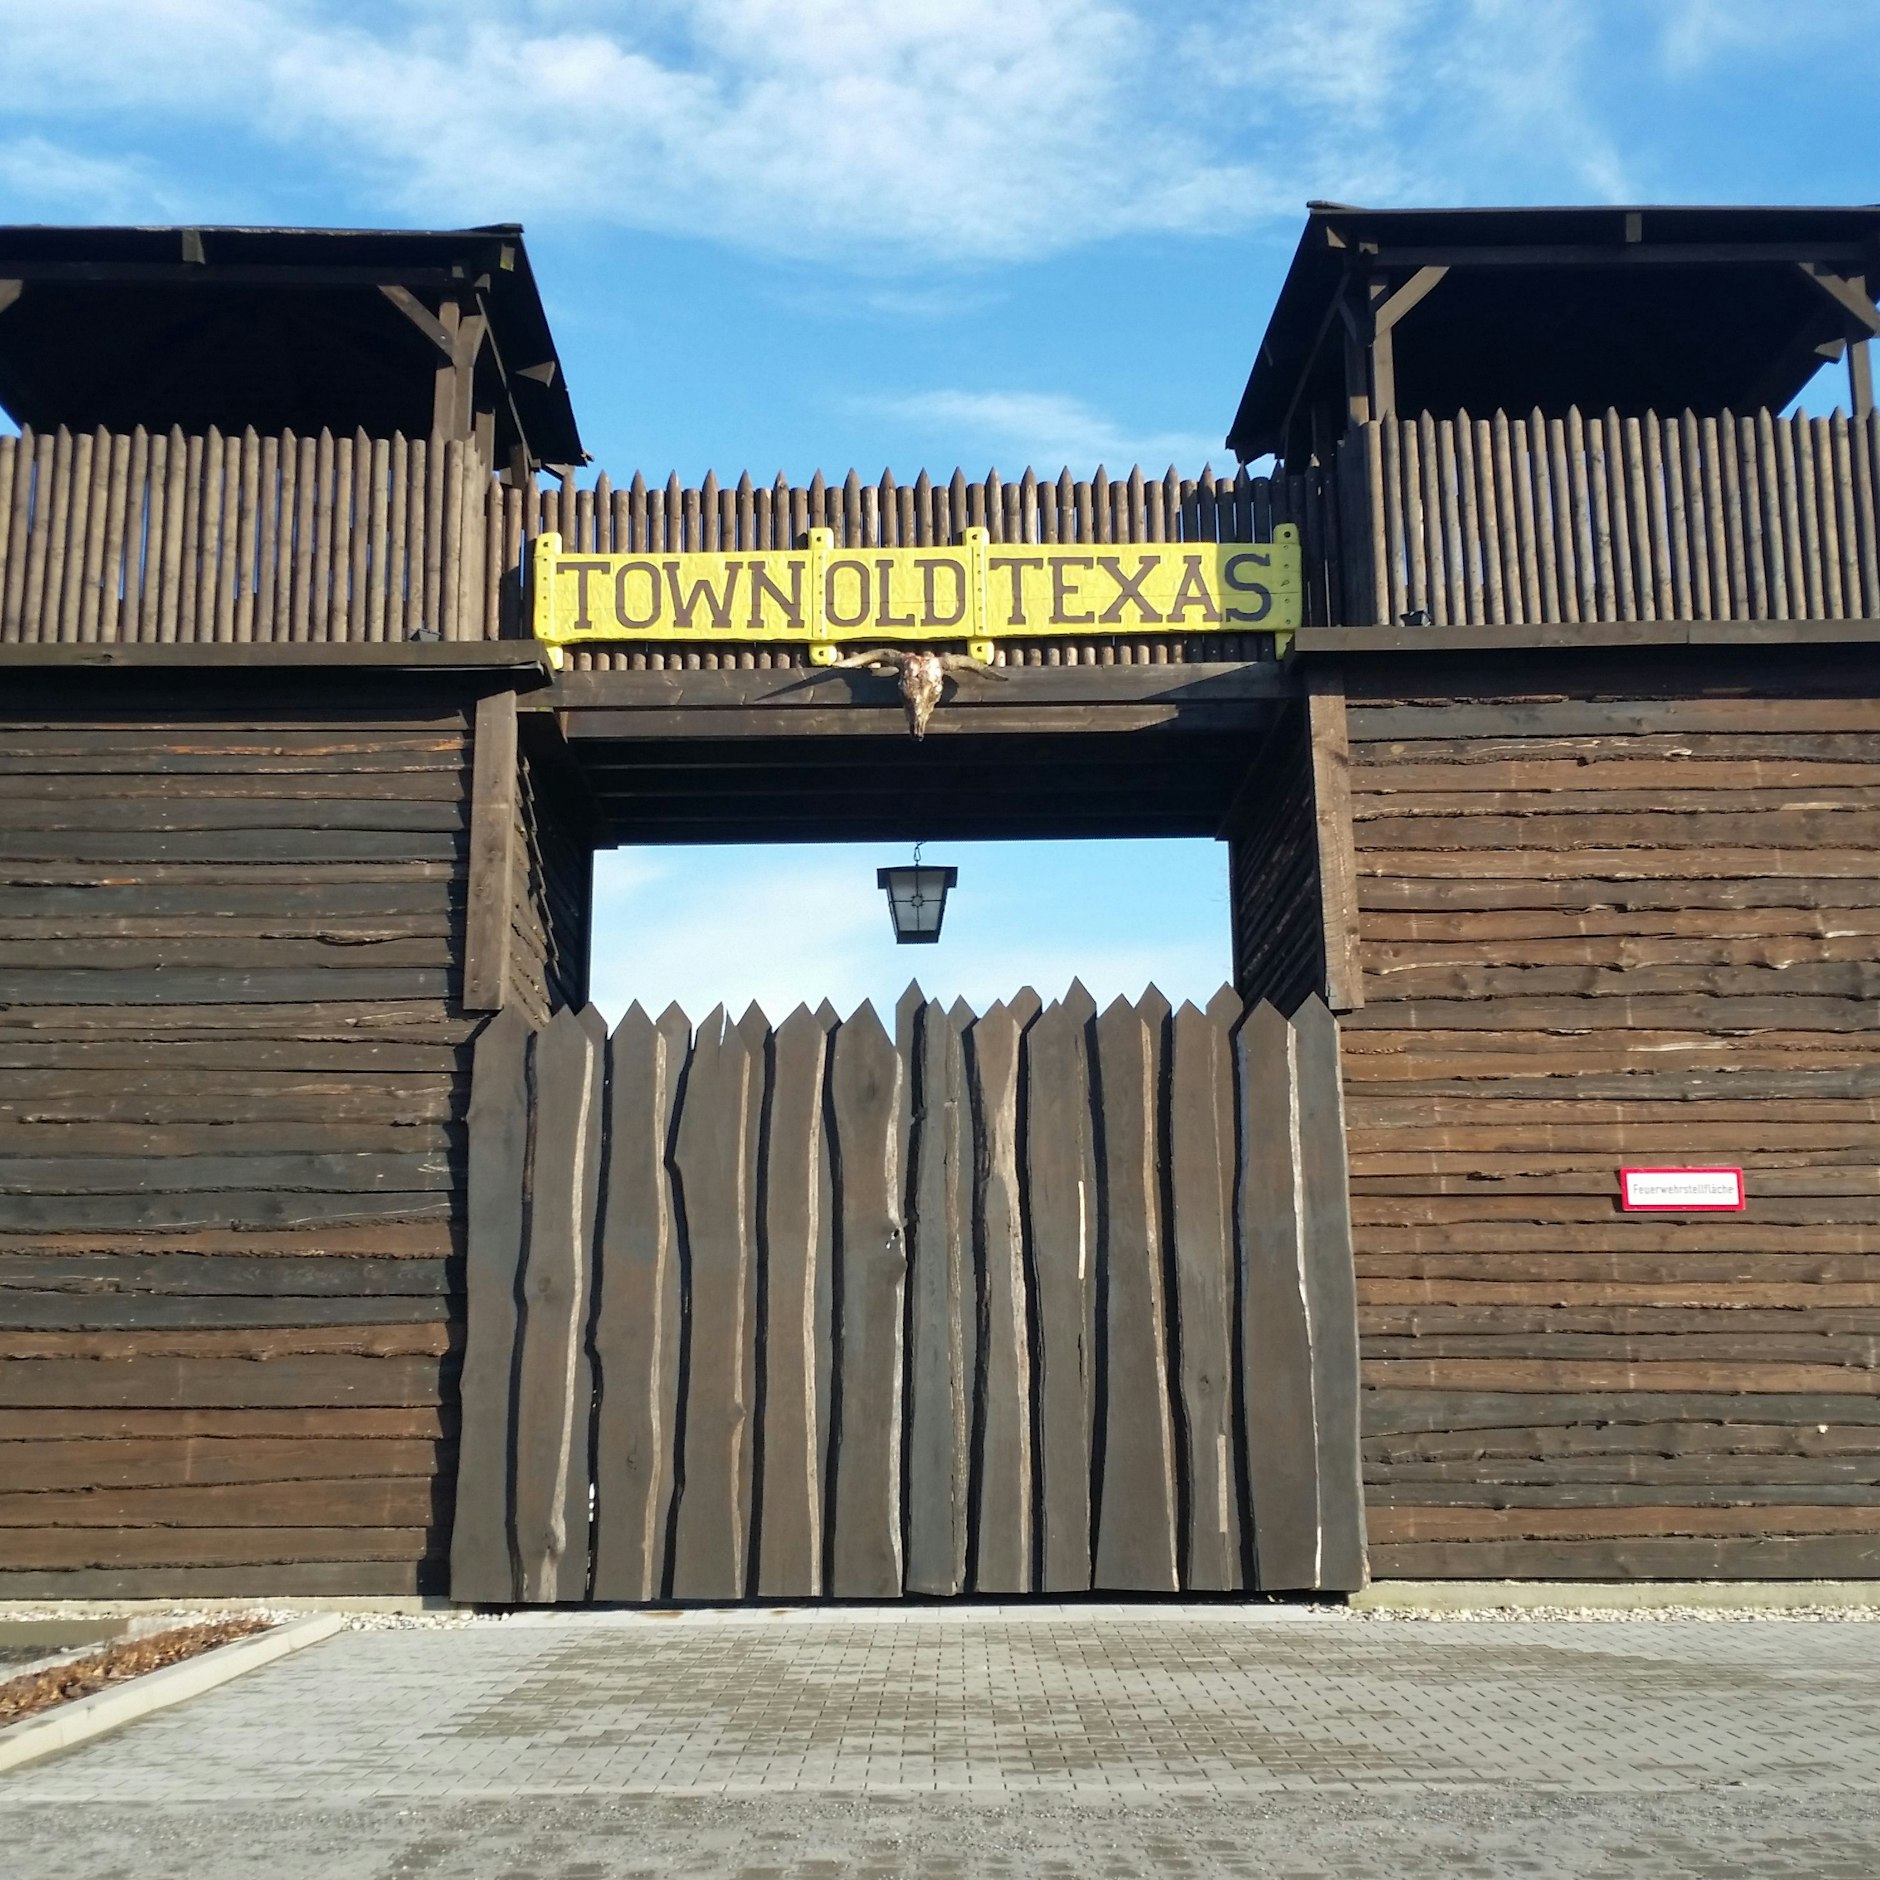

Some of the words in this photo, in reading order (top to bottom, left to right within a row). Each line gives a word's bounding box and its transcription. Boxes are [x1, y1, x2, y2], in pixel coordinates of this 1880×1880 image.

[556, 560, 805, 630] TOWN
[825, 558, 966, 627] OLD
[989, 553, 1272, 625] TEXAS
[1633, 1183, 1734, 1194] Feuerwehrstellfläche
